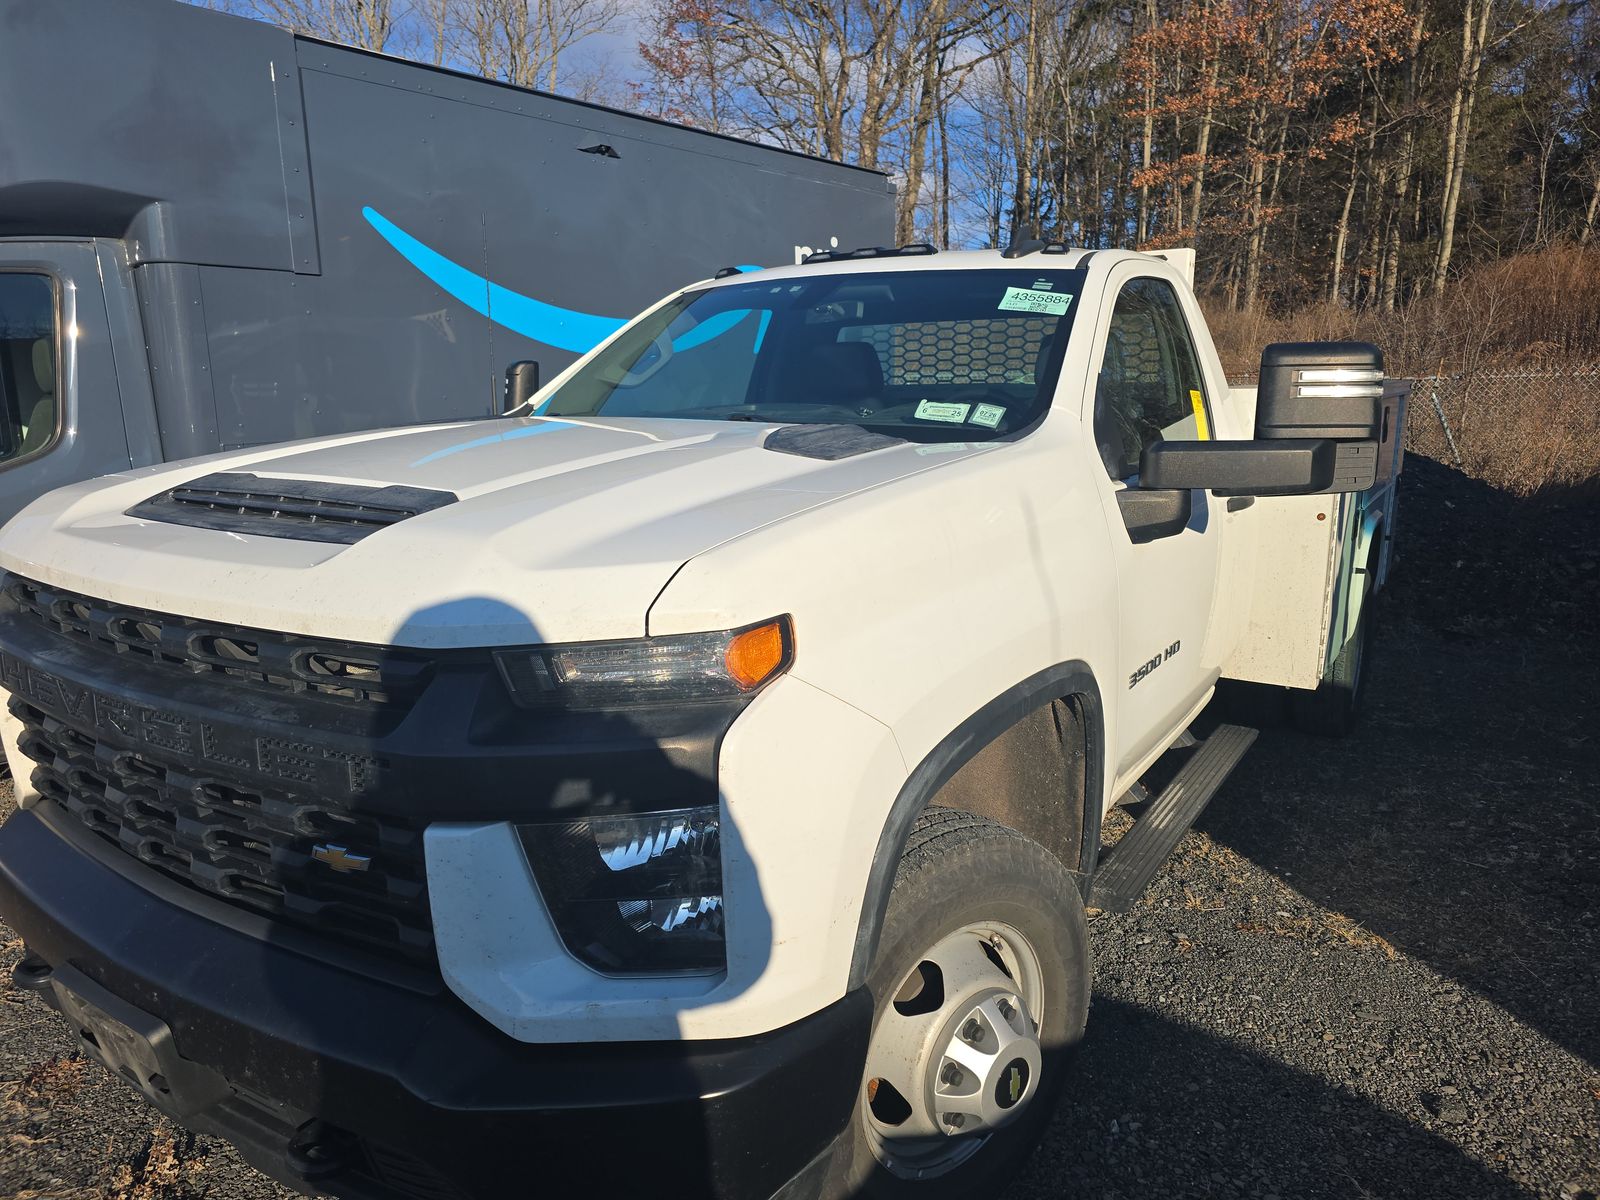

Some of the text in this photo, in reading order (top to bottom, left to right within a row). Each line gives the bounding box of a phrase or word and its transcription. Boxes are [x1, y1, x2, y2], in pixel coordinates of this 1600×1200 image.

[1011, 292, 1070, 305] 4355884
[1128, 640, 1181, 690] 3500 HD
[0, 650, 391, 793] HEVROLET
